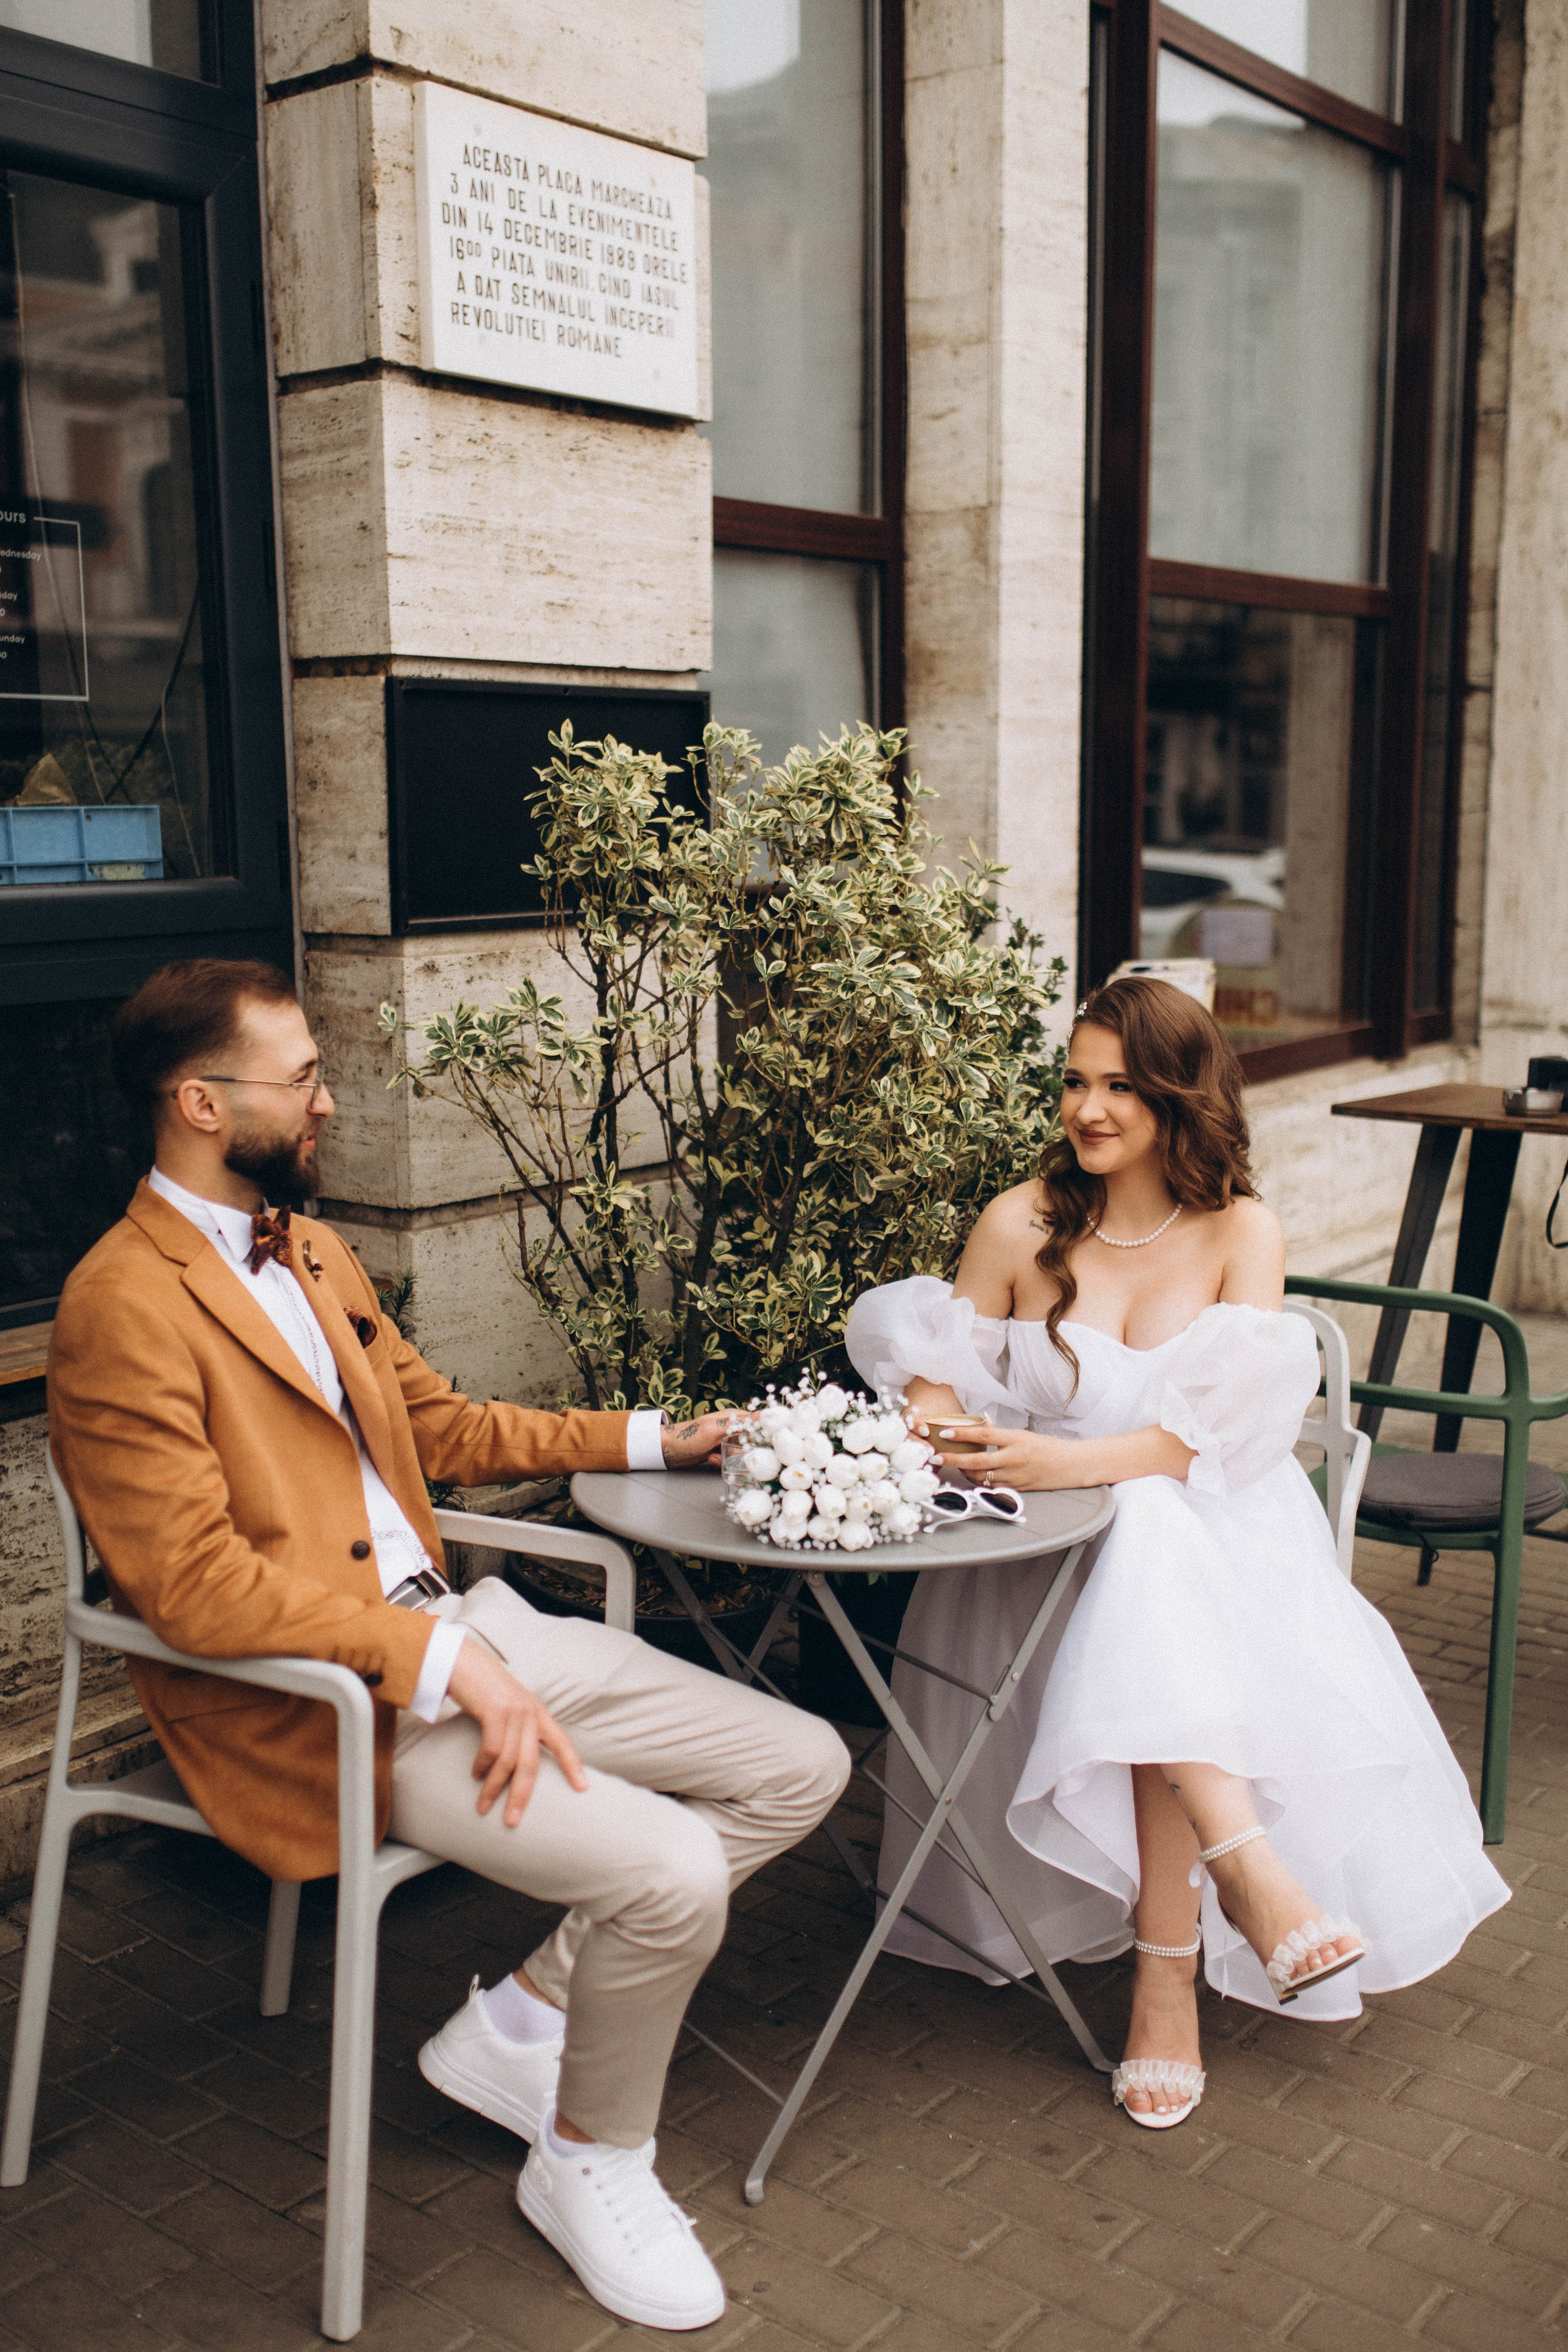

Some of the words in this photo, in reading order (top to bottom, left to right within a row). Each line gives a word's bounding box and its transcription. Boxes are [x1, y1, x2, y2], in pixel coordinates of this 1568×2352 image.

[450, 172, 459, 194] 3
[469, 177, 495, 204] ANI
[507, 186, 527, 213] DE
[538, 195, 558, 221] LA
[568, 203, 679, 252] EVENIMENTELE
[441, 202, 467, 230] DIN
[478, 210, 494, 236] 14
[503, 217, 593, 261] DECEMBRIE
[600, 242, 636, 271] 1989
[643, 252, 688, 284] ORELE
[456, 270, 466, 294] A
[474, 274, 502, 301] DAT
[511, 282, 595, 322] SEMNALUL
[598, 272, 631, 299] CIND
[450, 301, 546, 343] REVOLUTIEI
[556, 323, 622, 358] ROMANE
